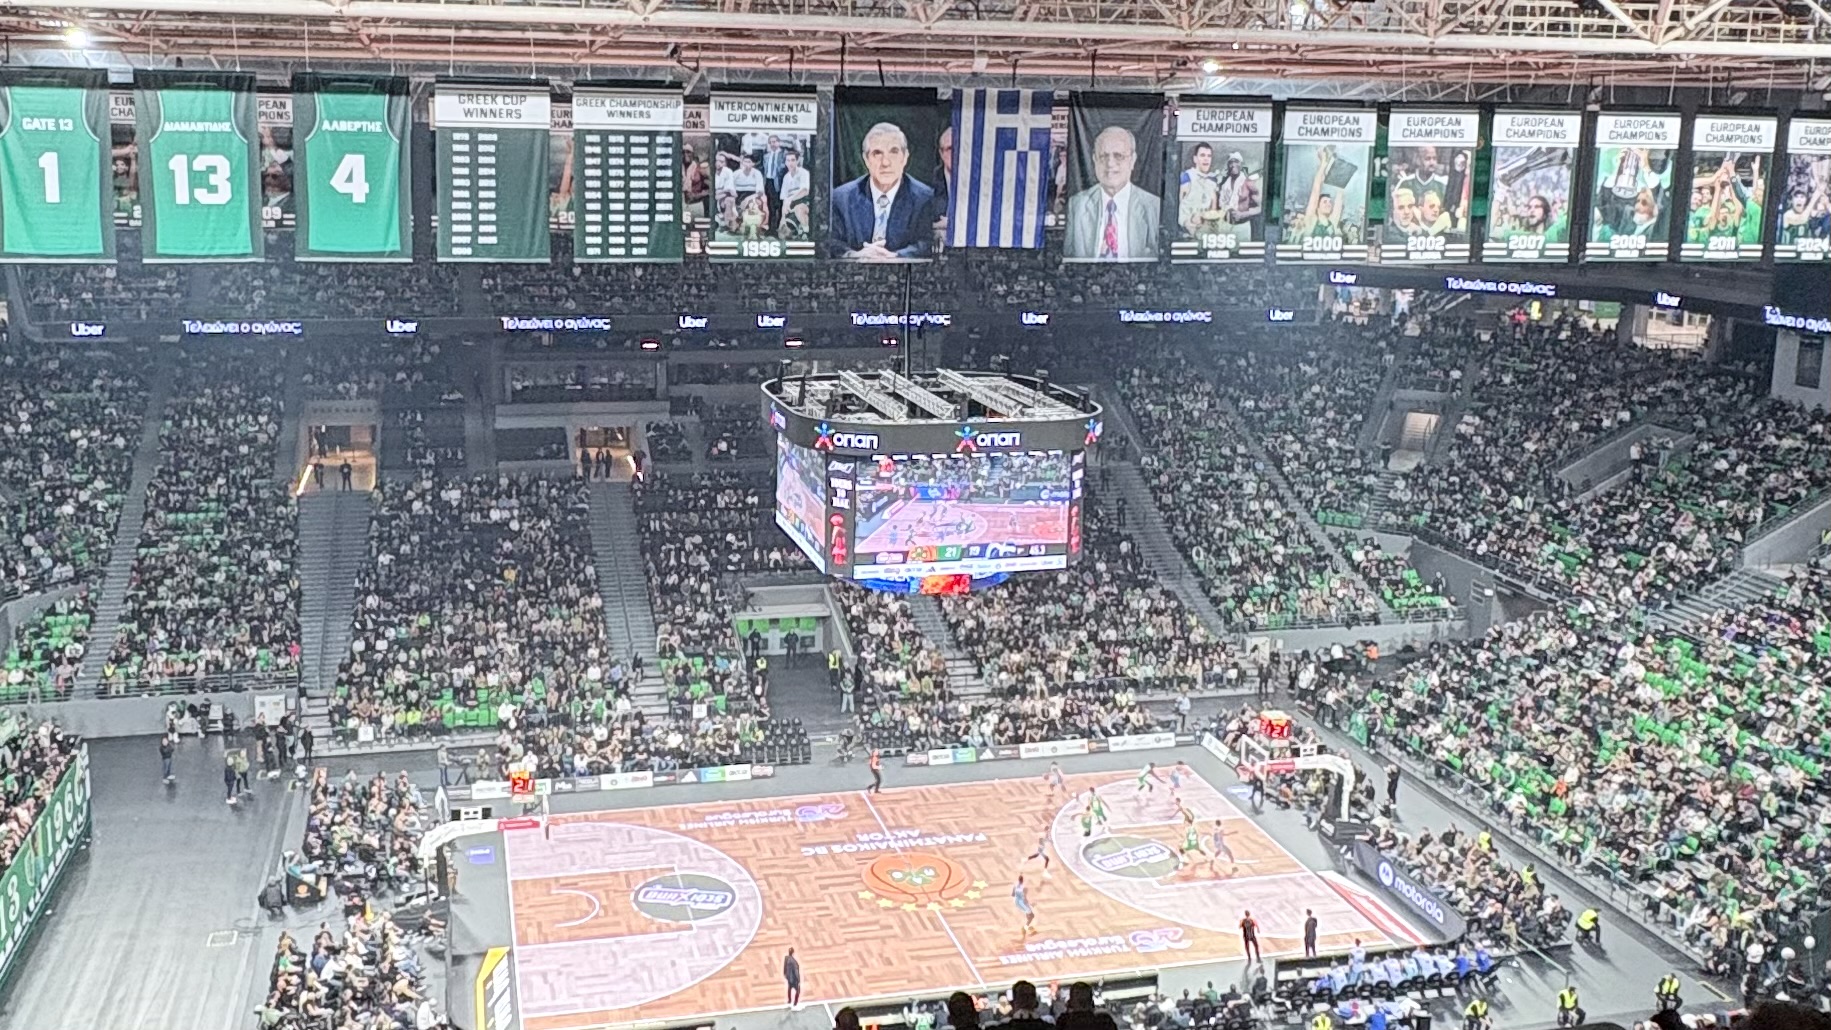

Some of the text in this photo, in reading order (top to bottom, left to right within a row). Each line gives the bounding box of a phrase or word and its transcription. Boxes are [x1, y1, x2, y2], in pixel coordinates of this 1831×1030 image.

[458, 93, 527, 106] GREEK CUP
[576, 98, 682, 110] GREEK CHAMPIONSHIP
[464, 107, 522, 120] WINNERS
[714, 101, 812, 114] INTERCONTINENTAL
[606, 109, 652, 120] WINNERS
[727, 112, 799, 125] CUP WINNERS
[1195, 109, 1256, 122] EUROPEAN
[1302, 114, 1361, 127] EUROPEAN
[22, 118, 73, 131] GATE 13
[1191, 122, 1259, 134] CHAMPIONS
[1406, 116, 1462, 128] EUROPEAN
[1509, 117, 1565, 128] EUROPEAN
[1613, 119, 1666, 131] EUROPEAN
[1709, 122, 1761, 134] EUROPEAN
[1297, 126, 1363, 138] CHAMPIONS
[1401, 127, 1466, 139] CHAMPIONS
[1505, 128, 1567, 140] CHAMPIONS
[1608, 130, 1668, 142] CHAMPIONS
[1705, 132, 1763, 145] CHAMPIONS
[1799, 136, 1831, 146] CHAMP
[38, 151, 60, 204] 1
[168, 154, 232, 205] 13
[330, 154, 370, 203] 4
[1202, 233, 1237, 250] 1996
[1303, 236, 1343, 251] 2000
[1407, 235, 1446, 251] 2002
[1508, 234, 1546, 250] 2007
[1610, 234, 1646, 250] 2009
[1708, 236, 1736, 250] 2011
[742, 242, 781, 257] 1996
[1330, 271, 1356, 285] Uber
[1656, 292, 1681, 306] Uber
[679, 315, 708, 328] Uber
[757, 315, 785, 328] Uber
[1021, 312, 1049, 325] Uber
[1269, 309, 1294, 322] Uber
[71, 322, 104, 336] Uber
[387, 320, 418, 335] Uber
[856, 828, 920, 842] AKTOR
[802, 832, 987, 857] PANATHINAIKOS BC
[1394, 876, 1444, 924] motorola
